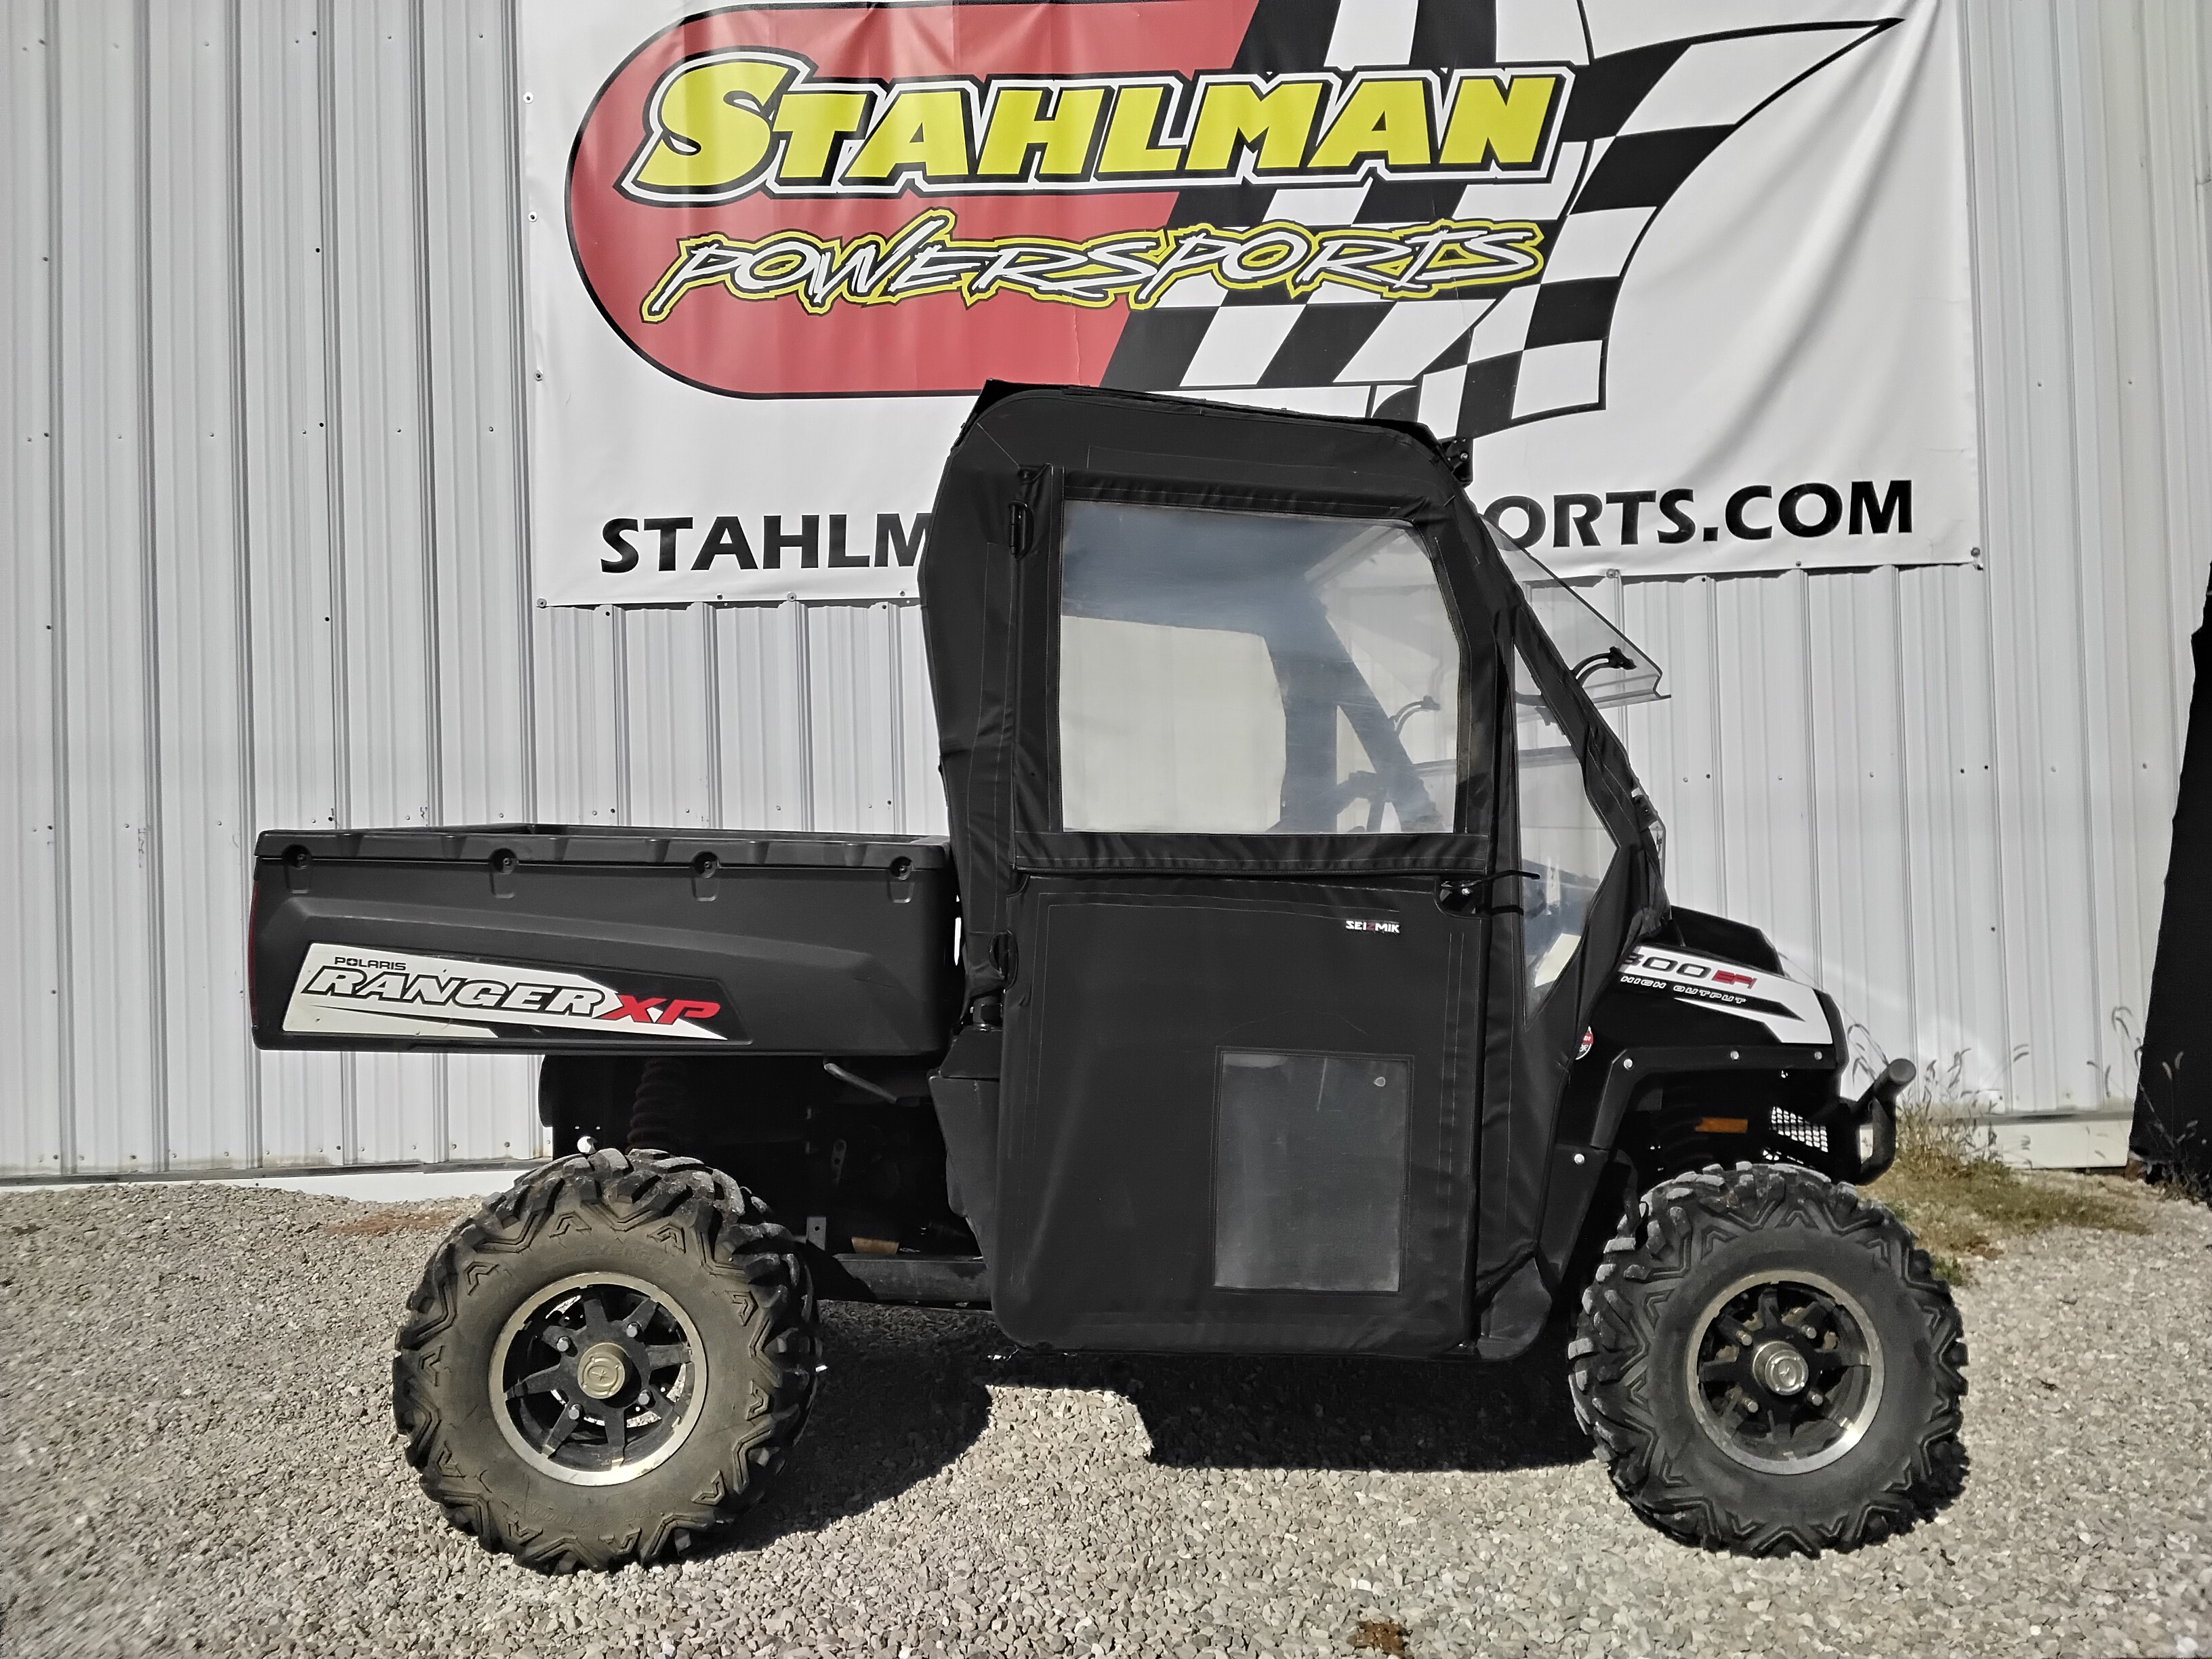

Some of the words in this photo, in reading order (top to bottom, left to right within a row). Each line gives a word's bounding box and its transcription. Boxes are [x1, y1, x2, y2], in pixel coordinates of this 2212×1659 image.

[625, 53, 1572, 198] STAHLMAN
[642, 209, 1543, 321] POWERSPORTS
[1345, 920, 1400, 934] SEIZMIK
[334, 956, 407, 971] POLARIS
[301, 965, 606, 1018] RANGER
[593, 994, 721, 1025] XP
[1620, 976, 1667, 989] HIGH
[1673, 985, 1746, 1004] OUTPUT
